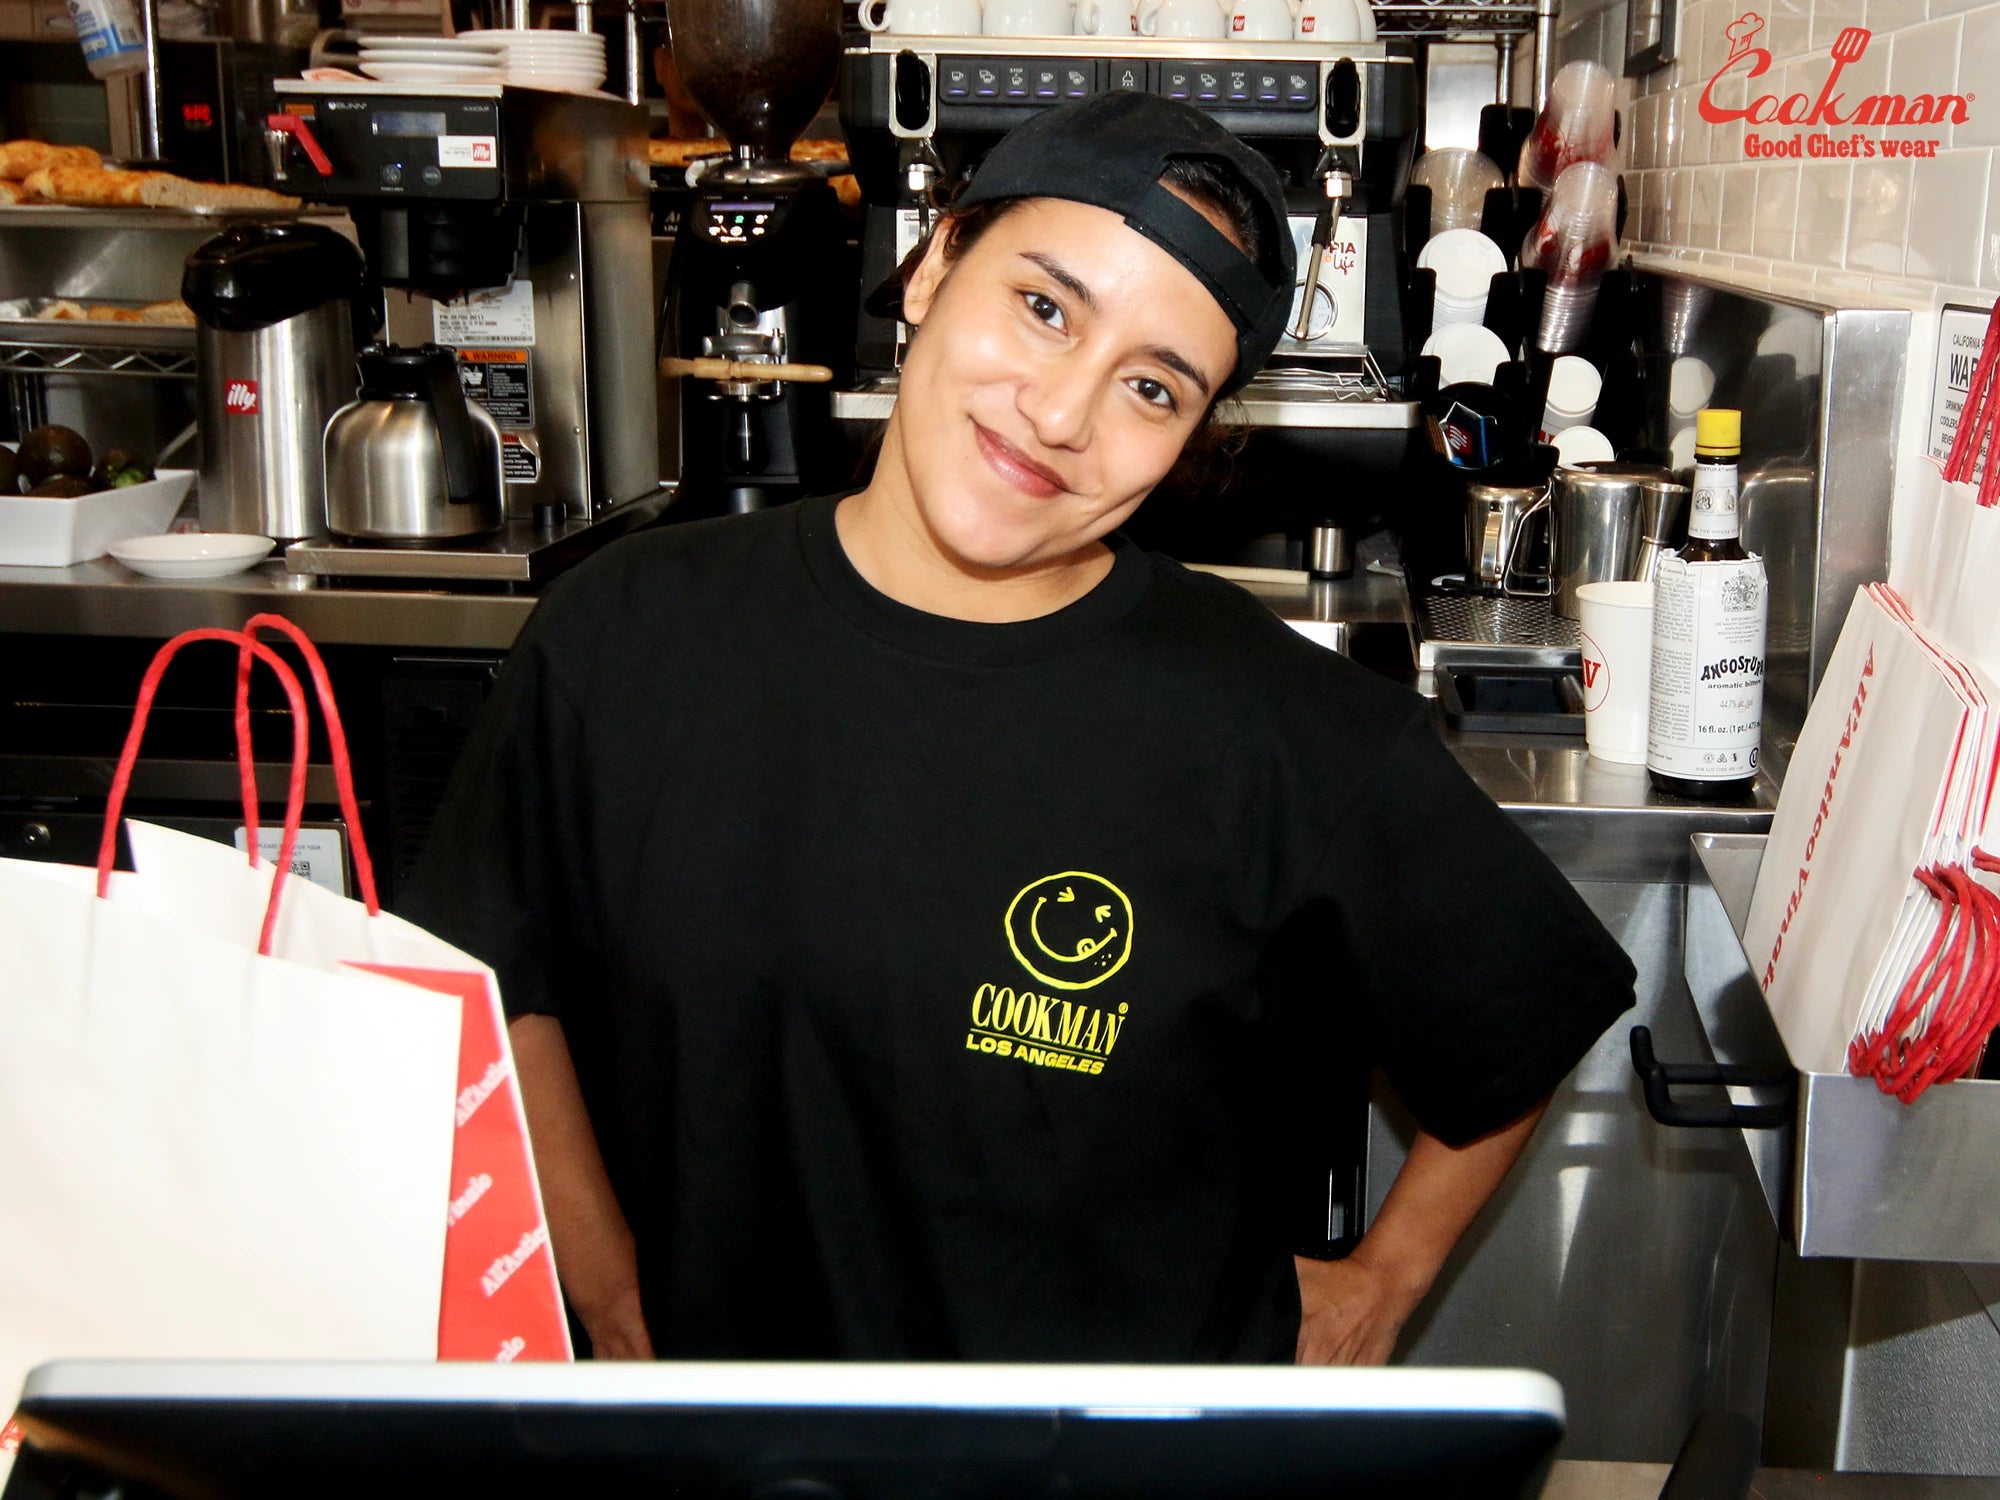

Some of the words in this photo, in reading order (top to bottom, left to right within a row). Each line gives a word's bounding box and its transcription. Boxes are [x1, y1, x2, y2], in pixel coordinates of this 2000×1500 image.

[227, 383, 256, 411] illy
[1707, 681, 1744, 689] aromatic
[1699, 725, 1707, 733] 16
[1717, 725, 1729, 733] oz.
[972, 982, 1127, 1055] COOKMAN
[966, 1033, 1013, 1056] LOS
[1014, 1044, 1105, 1075] ANGELES
